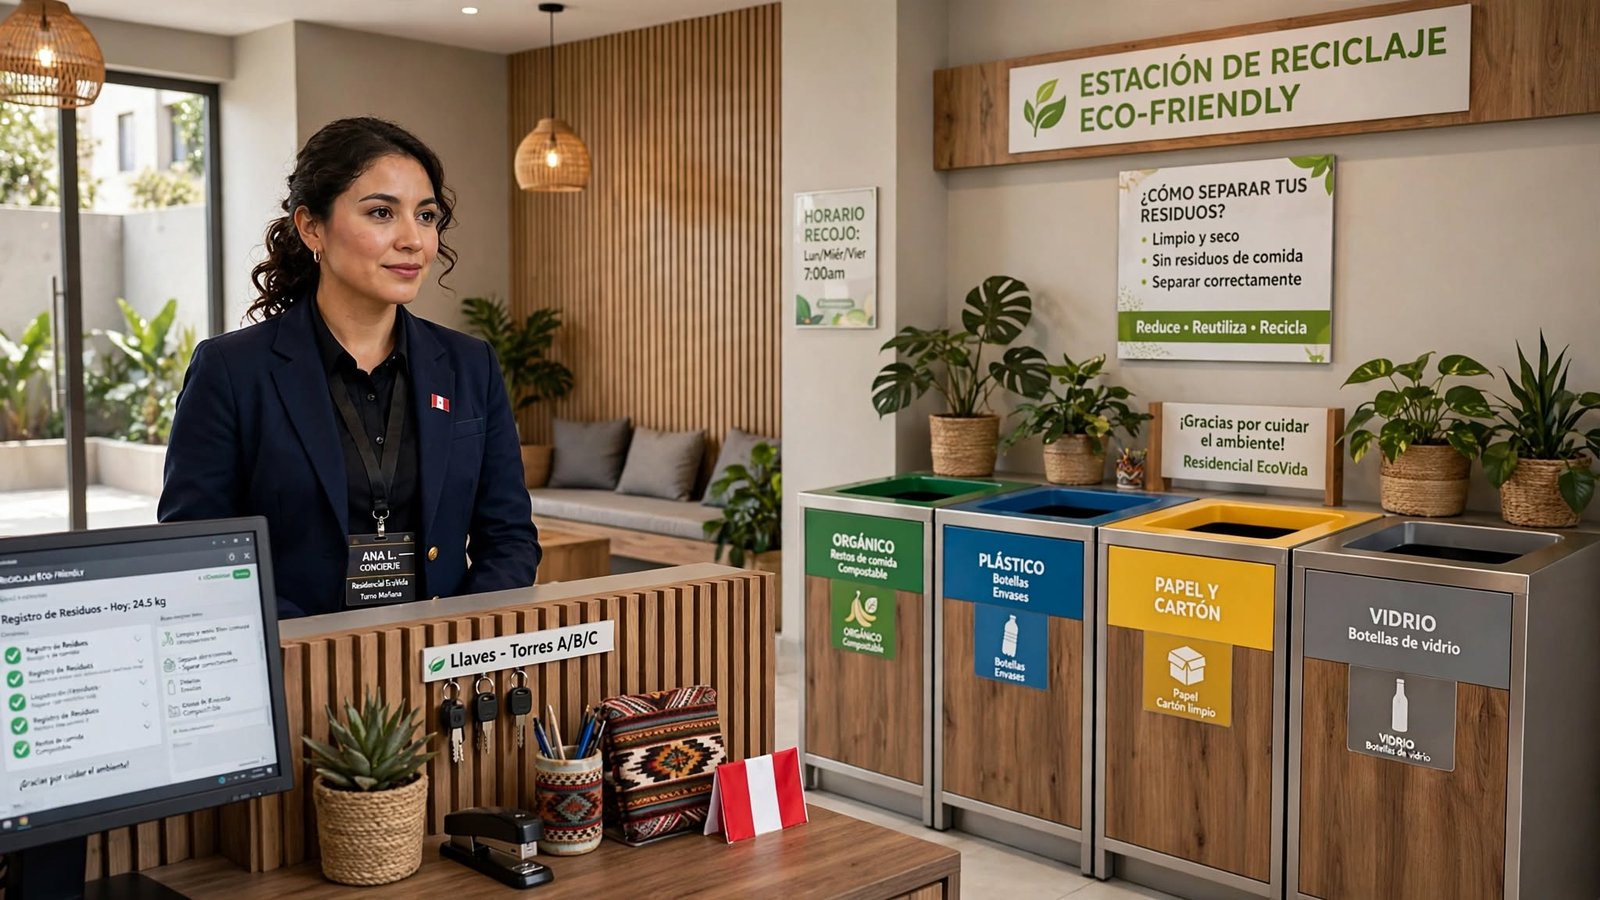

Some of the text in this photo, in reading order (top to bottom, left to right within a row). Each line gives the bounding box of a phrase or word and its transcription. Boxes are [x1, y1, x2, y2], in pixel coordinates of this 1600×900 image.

[1080, 26, 1448, 97] ESTACIÓN DE RECICLAJE
[1080, 84, 1301, 133] ECO-FRIENDLY
[1140, 177, 1308, 207] ¿CÓMO SEPARAR TUS
[804, 206, 865, 224] HORARIO
[1141, 204, 1226, 223] RESIDUOS?
[804, 226, 860, 242] RECOJO:
[1152, 231, 1240, 247] Limpio y seco
[803, 247, 867, 262] Lun/Miér/Vier
[1152, 248, 1303, 267] Sin residuos de comida
[803, 266, 845, 280] 7:00am
[1152, 273, 1302, 291] Separar correctamente
[1136, 319, 1307, 335] Reduce Reutiliza Recicla
[1180, 414, 1310, 433] ¡Gracias por cuidar
[1201, 433, 1285, 451] el ambiente!
[1183, 454, 1308, 476] Residencial EcoVida
[832, 532, 895, 554] ORGÁNICO
[362, 550, 397, 561] ANA L.
[830, 549, 897, 568] Restos de comida
[979, 551, 1045, 575] PLÁSTICO
[838, 563, 888, 580] Compostable
[993, 573, 1029, 588] Botellas
[993, 587, 1029, 603] Envases
[1155, 576, 1219, 600] PAPEL Y
[1, 612, 42, 626] Registro
[44, 610, 57, 619] de
[59, 605, 102, 618] Residuos
[133, 598, 153, 609] 24.5
[155, 597, 167, 608] kg
[1154, 597, 1221, 622] CARTÓN
[1369, 607, 1437, 632] VIDRIO
[843, 627, 882, 642] ORGÁNICO
[1348, 626, 1461, 655] Botellas de vidrio
[450, 649, 496, 668] Llaves
[510, 639, 553, 659] Torres
[557, 631, 598, 652] A/B/C
[994, 656, 1025, 671] Botellas
[994, 668, 1025, 682] Envases
[1173, 688, 1199, 702] Papel
[1156, 697, 1216, 718] Cartón limpio
[1378, 732, 1415, 750] VIDRIO
[1365, 740, 1431, 762] Botellas de vidrio
